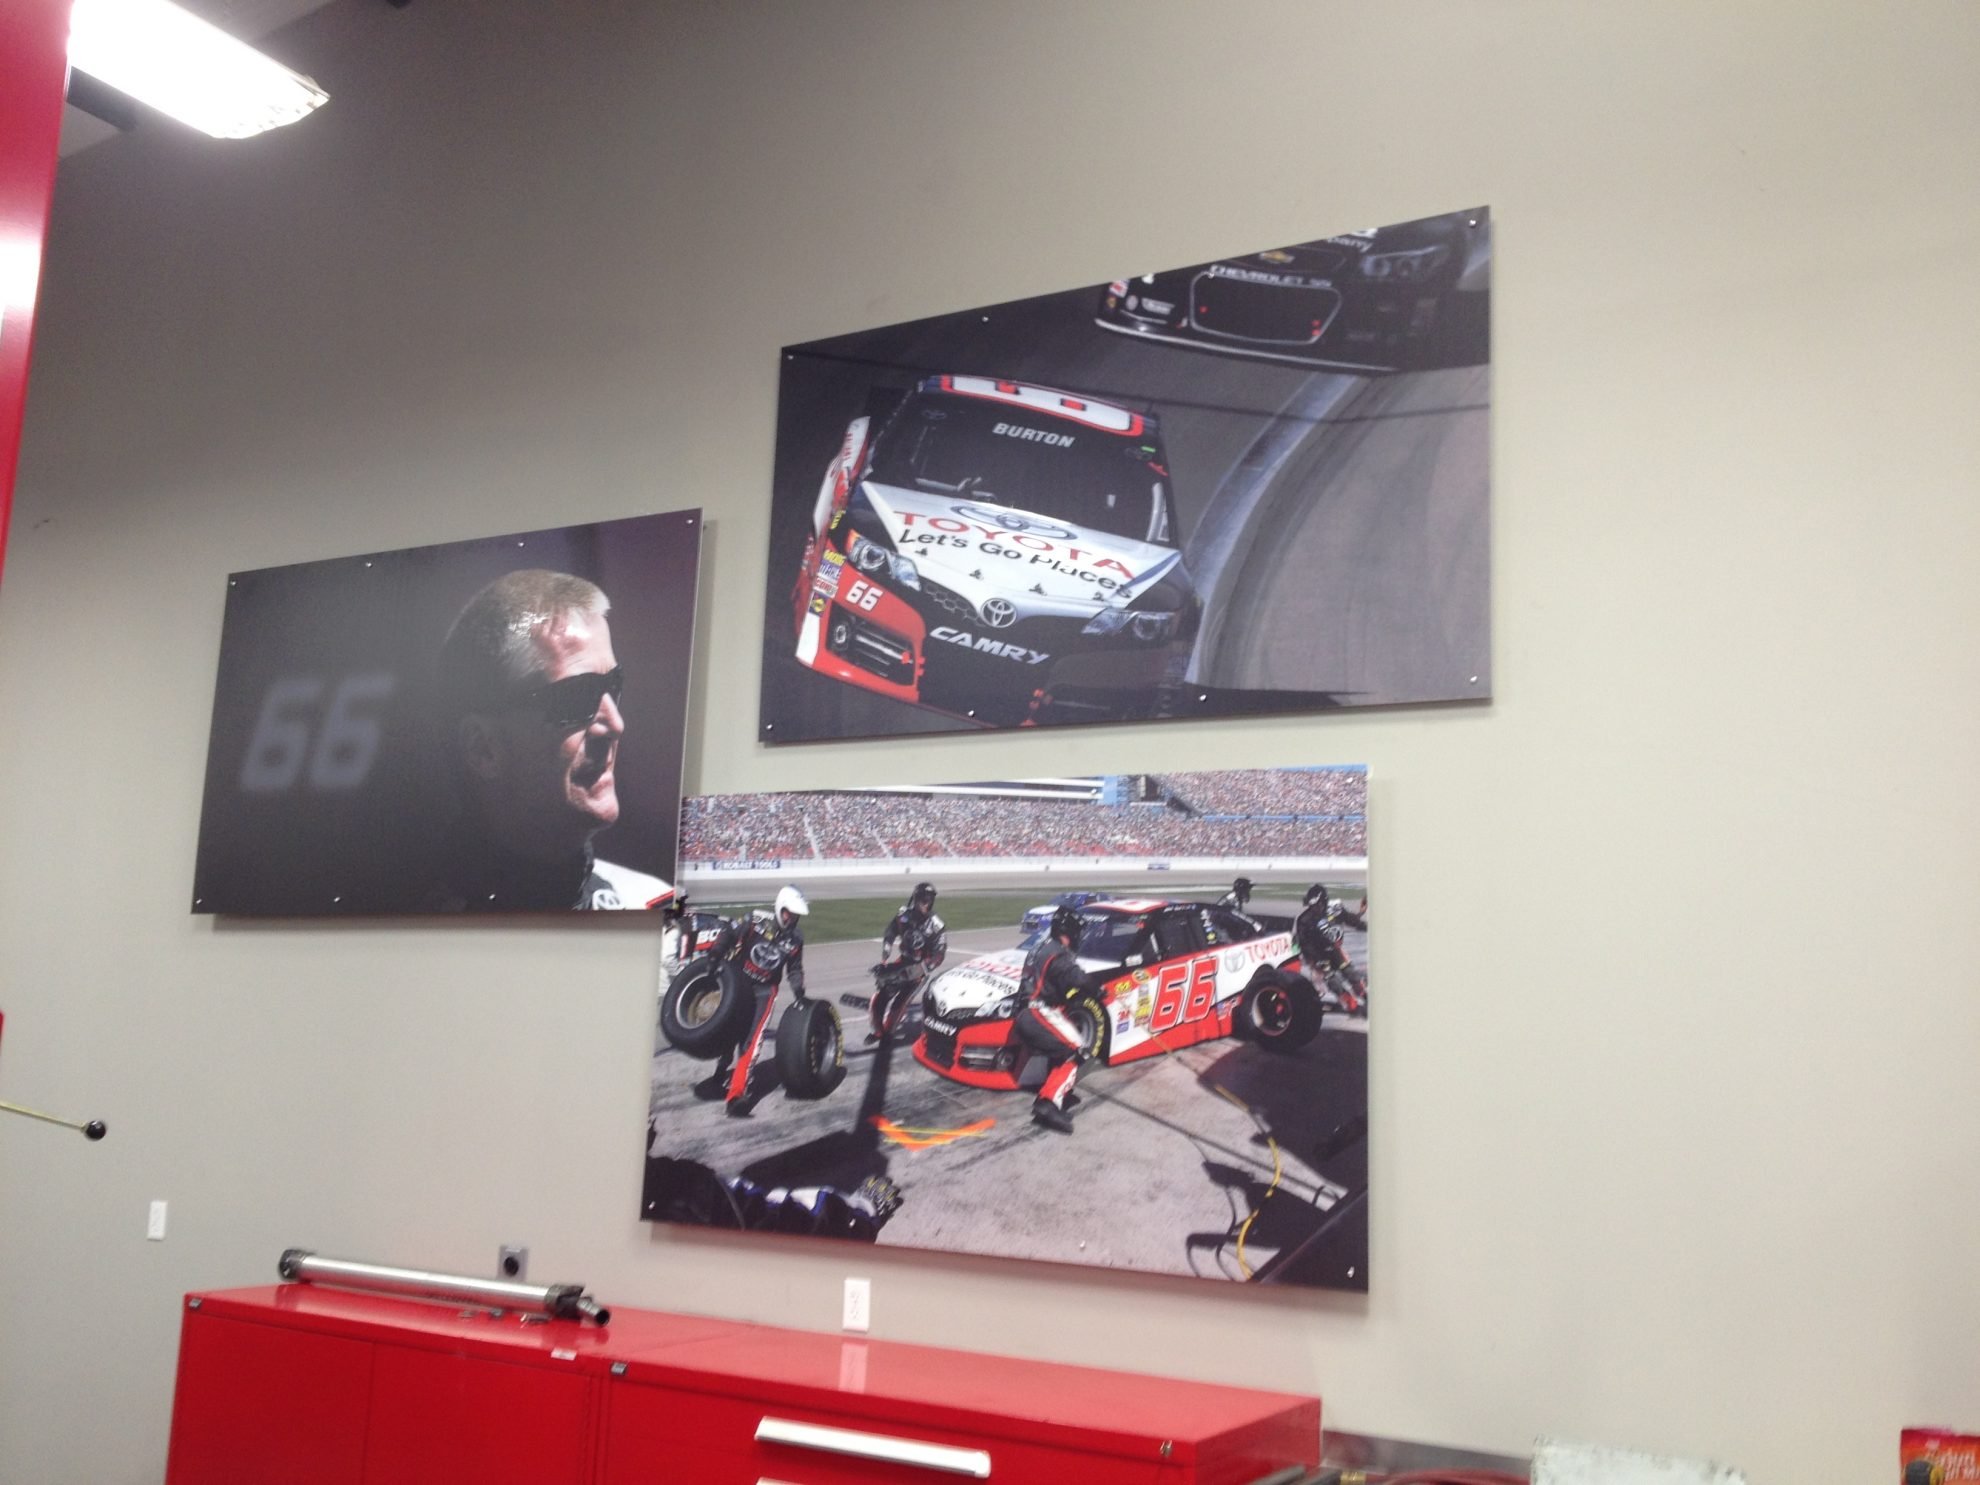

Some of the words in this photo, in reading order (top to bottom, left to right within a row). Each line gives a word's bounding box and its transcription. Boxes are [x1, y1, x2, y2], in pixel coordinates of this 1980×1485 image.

[991, 422, 1076, 448] BURTON
[893, 510, 1135, 580] TOYOTA
[899, 529, 968, 549] Let's
[979, 542, 1022, 560] Go
[1029, 554, 1133, 599] Places
[845, 580, 884, 611] 66
[929, 626, 1050, 665] CAMRY
[240, 673, 395, 790] 66
[1244, 938, 1291, 963] TOYOTA
[1148, 955, 1220, 1034] 66
[924, 1016, 957, 1036] CAMRY
